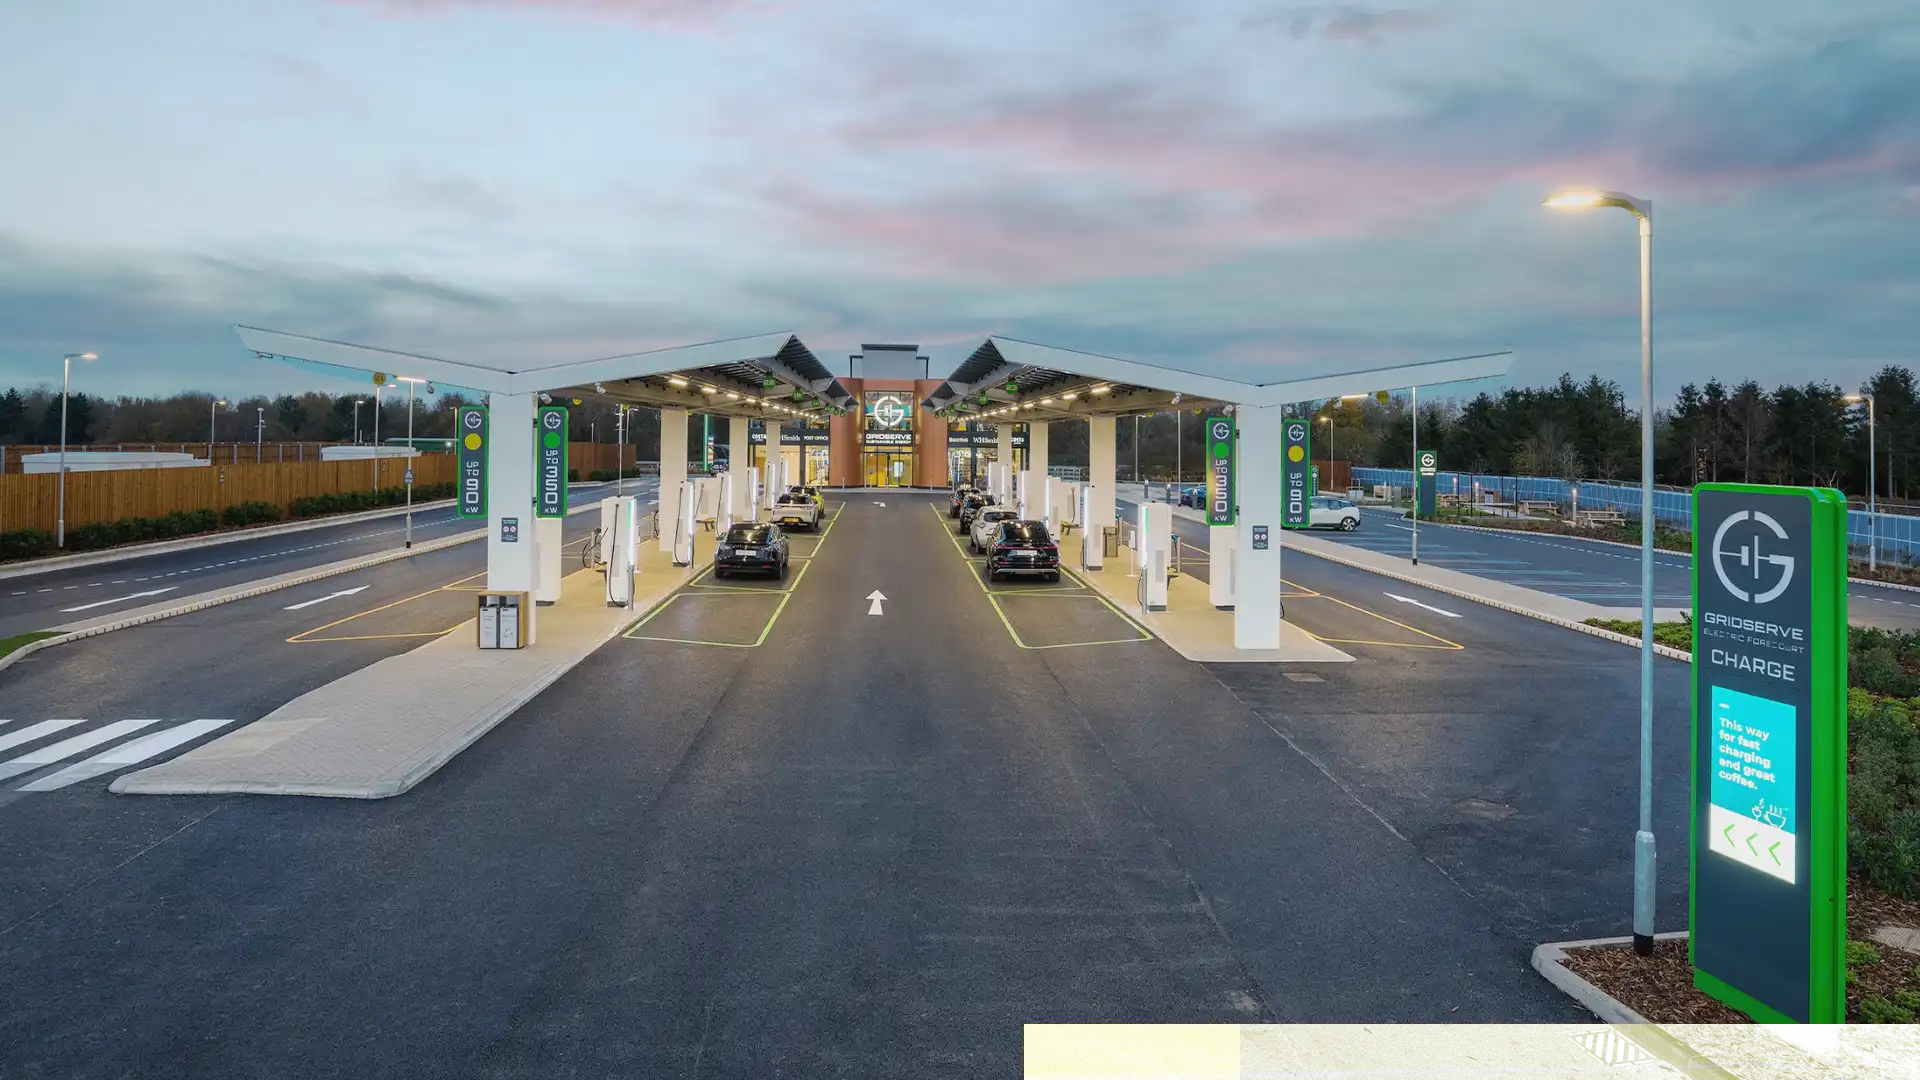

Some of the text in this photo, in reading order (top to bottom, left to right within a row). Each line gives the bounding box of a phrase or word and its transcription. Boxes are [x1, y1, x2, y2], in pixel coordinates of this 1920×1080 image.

[466, 478, 478, 504] 90
[545, 466, 558, 504] 350
[1215, 475, 1227, 512] 350
[1290, 489, 1302, 513] 90
[1704, 612, 1803, 640] GRIDSERVE
[1703, 628, 1804, 655] ELECTRIC FORECOURT
[1711, 649, 1795, 682] CHARGE
[1719, 717, 1769, 741] This way
[1719, 730, 1760, 751] for fast
[1719, 744, 1771, 769] charging
[1719, 757, 1776, 783] and great
[1719, 770, 1758, 790] coffee.
